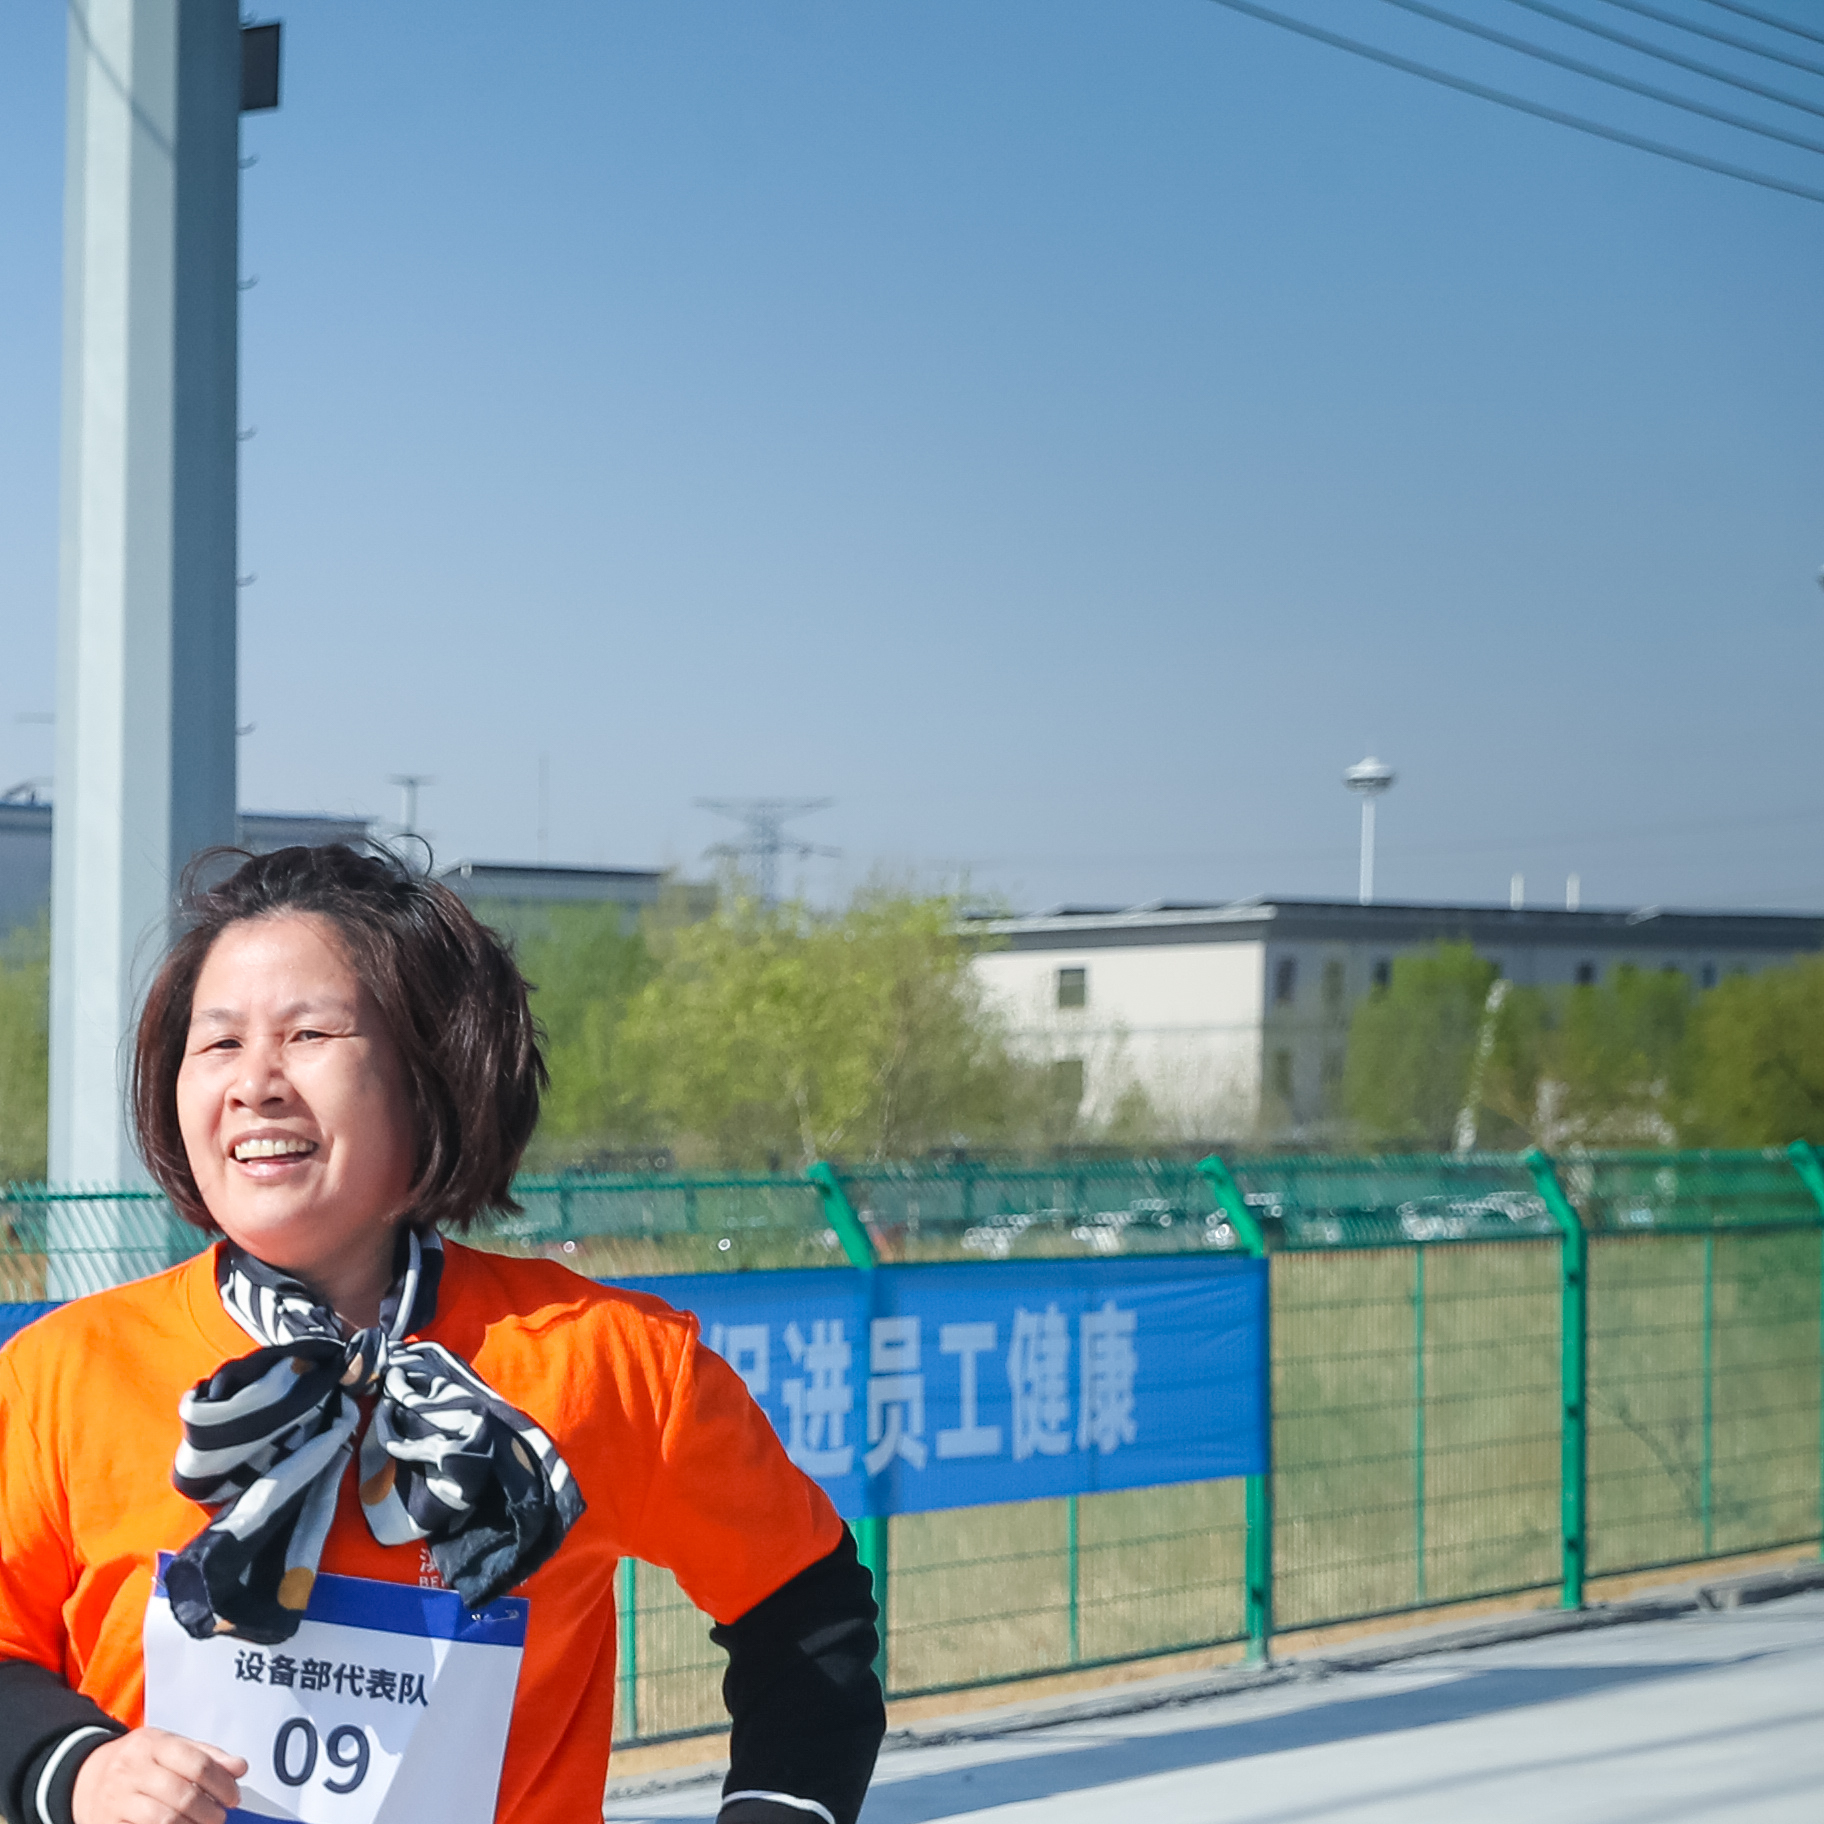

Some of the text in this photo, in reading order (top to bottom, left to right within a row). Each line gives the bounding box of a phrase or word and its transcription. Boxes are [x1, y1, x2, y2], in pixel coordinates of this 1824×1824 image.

[234, 1650, 429, 1707] 设备部代表队
[273, 1717, 370, 1794] 09
